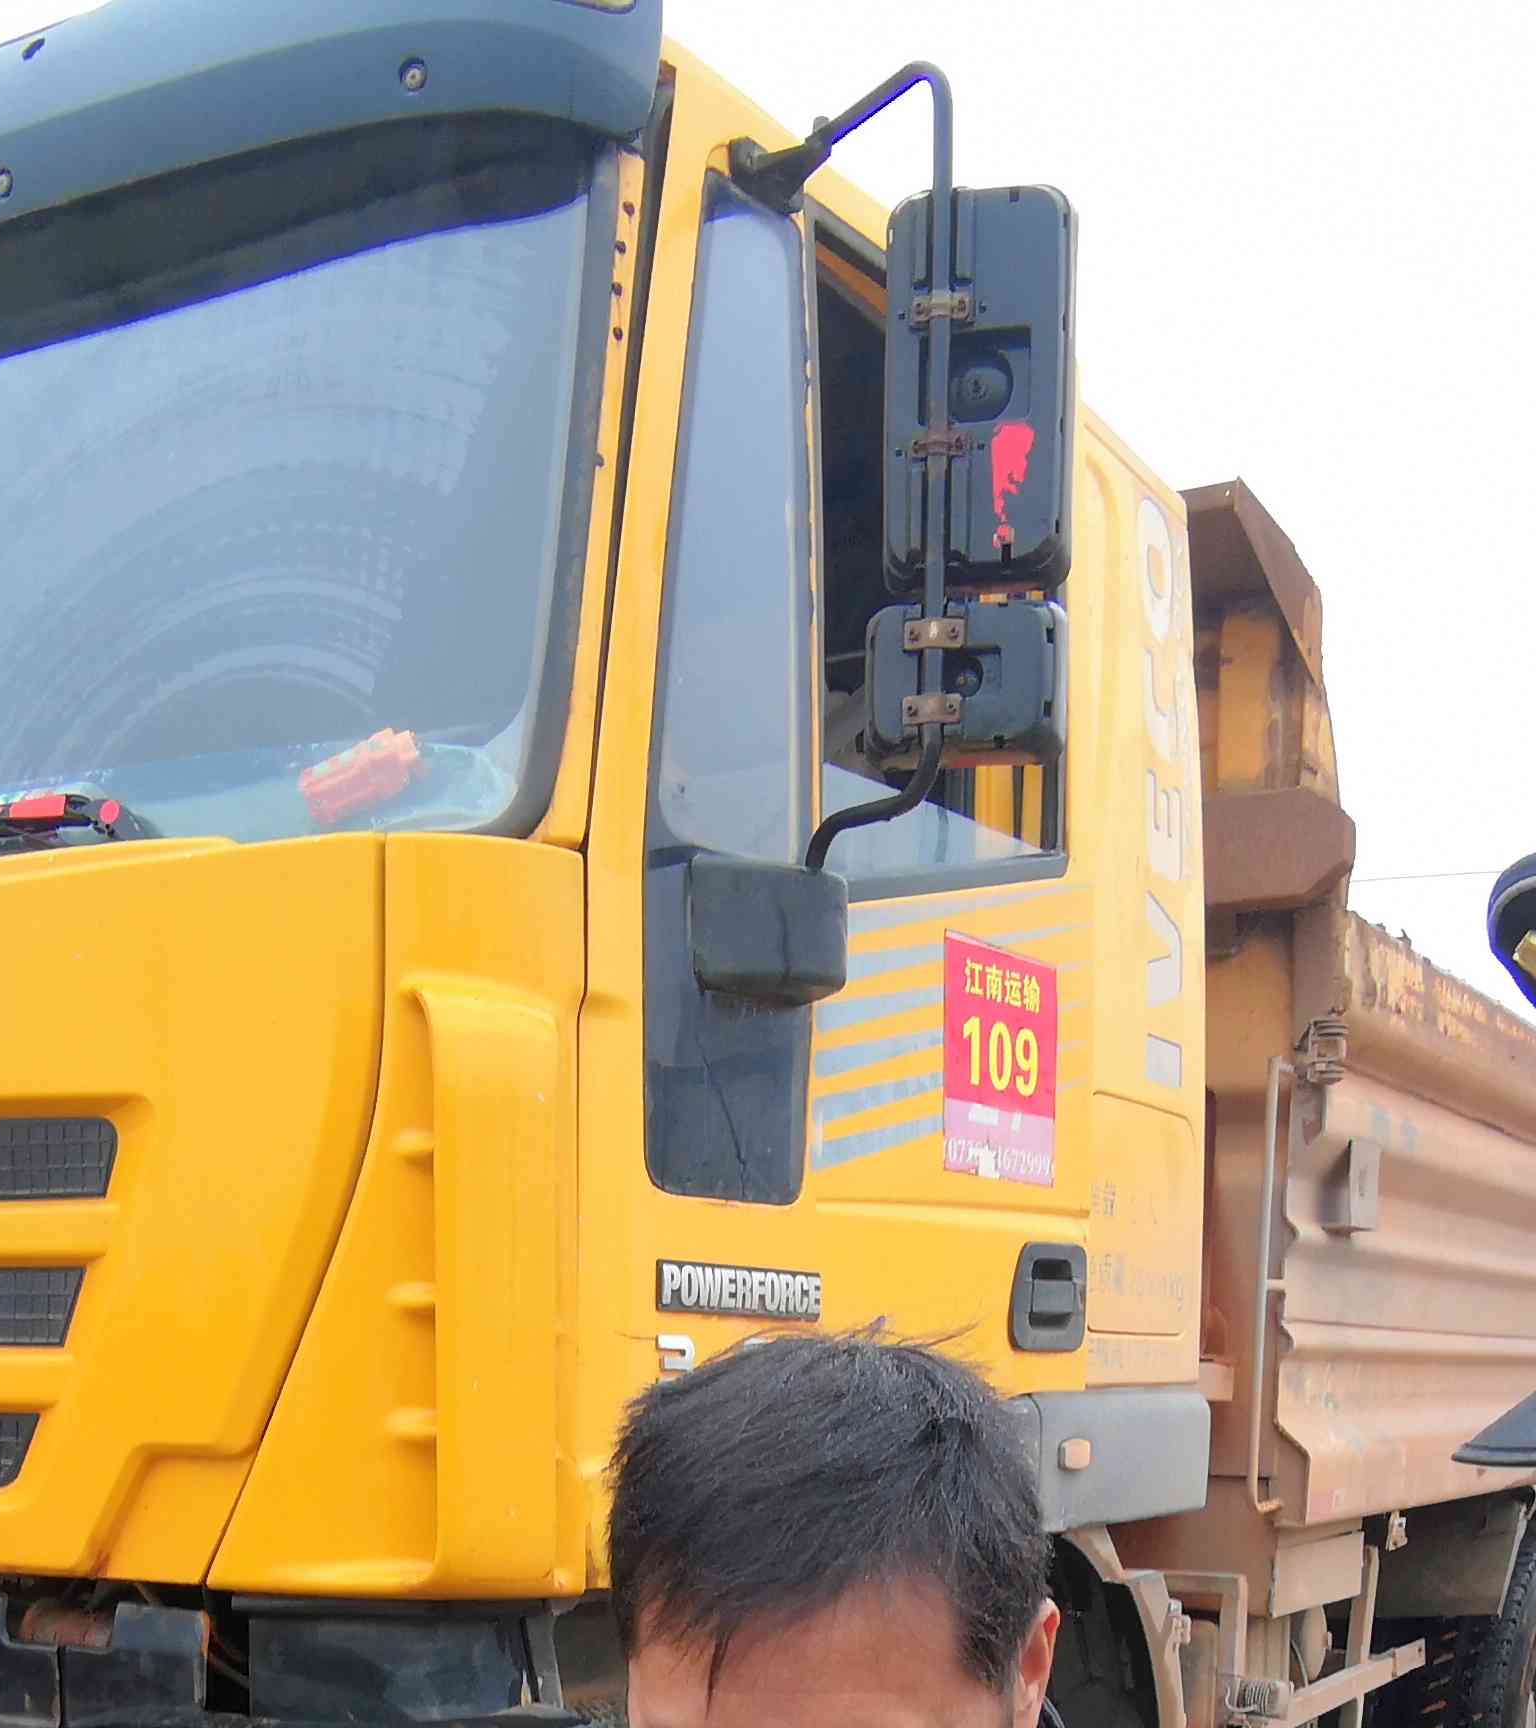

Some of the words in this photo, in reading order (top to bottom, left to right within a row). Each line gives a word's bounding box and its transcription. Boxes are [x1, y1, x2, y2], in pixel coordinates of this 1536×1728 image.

[1136, 494, 1185, 1090] IVECO
[964, 958, 1042, 1014] 江南运输
[962, 1015, 1040, 1098] 109
[661, 1262, 822, 1315] POWERFORCE
